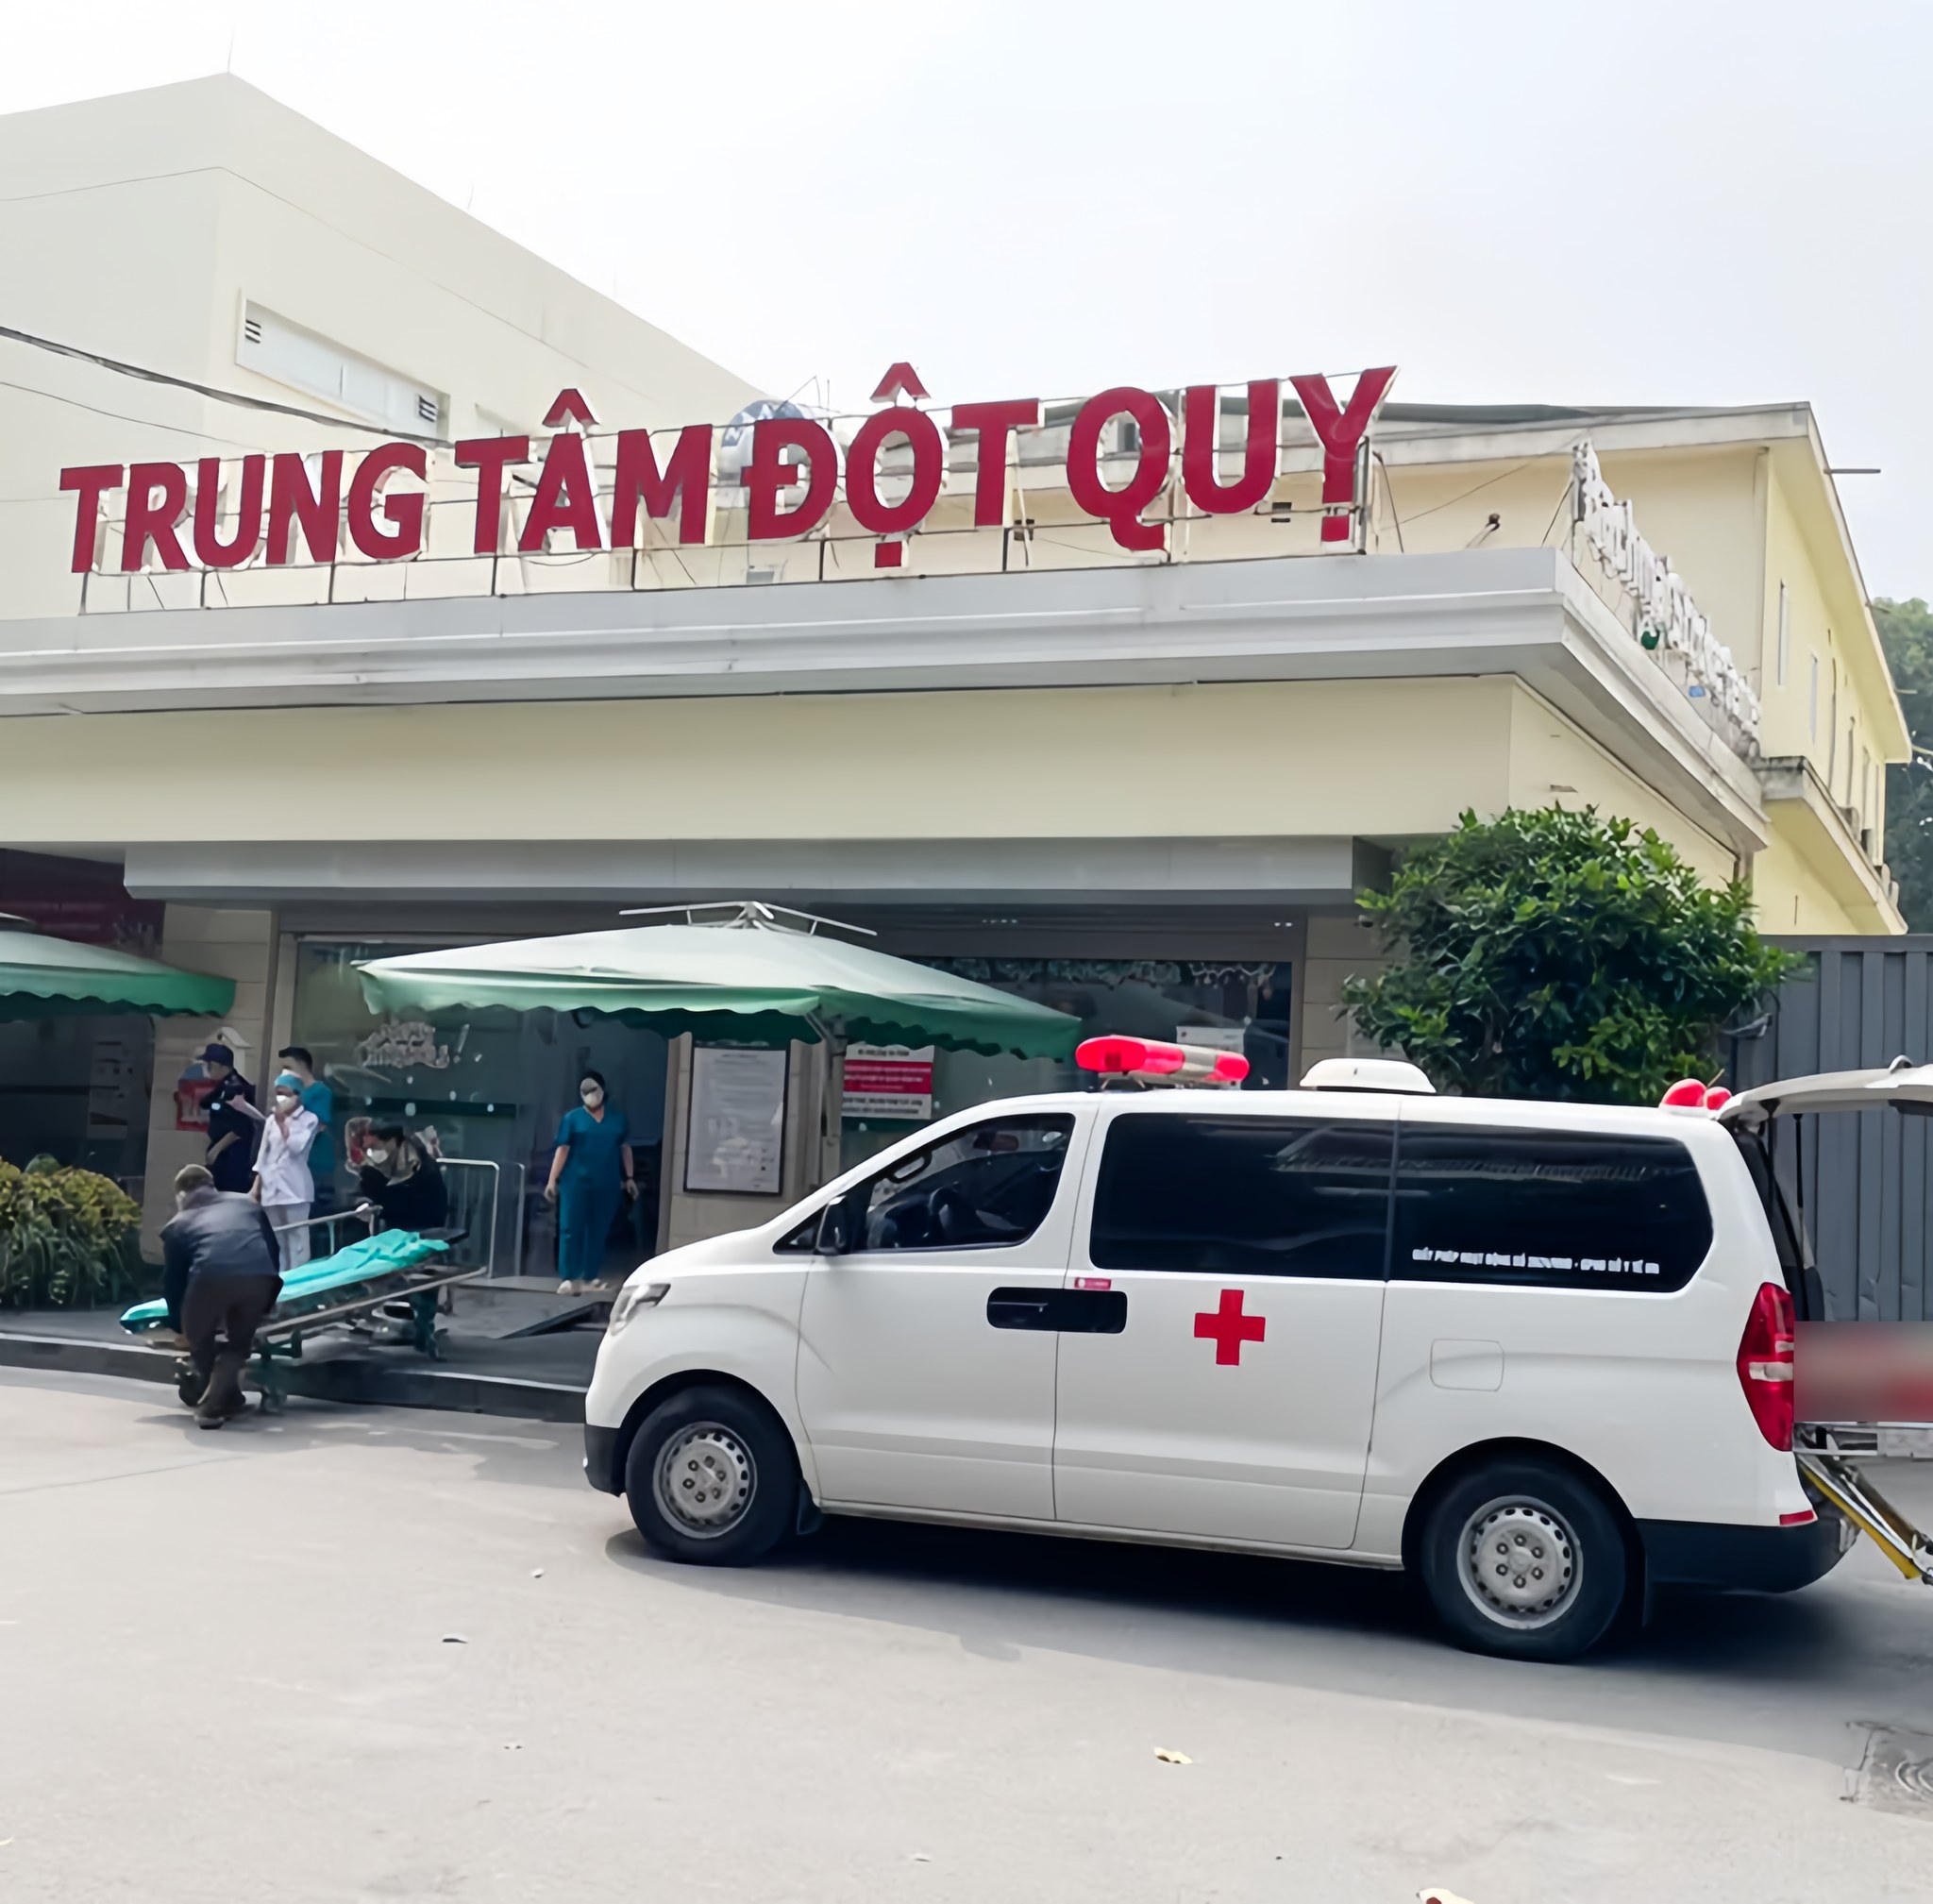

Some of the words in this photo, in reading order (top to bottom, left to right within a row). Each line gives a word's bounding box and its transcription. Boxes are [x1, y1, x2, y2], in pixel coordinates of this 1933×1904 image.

[59, 443, 426, 573] TRUNG
[454, 388, 712, 555] TÂM
[741, 362, 1039, 568] ĐỘT
[1067, 366, 1398, 550] QUỴ
